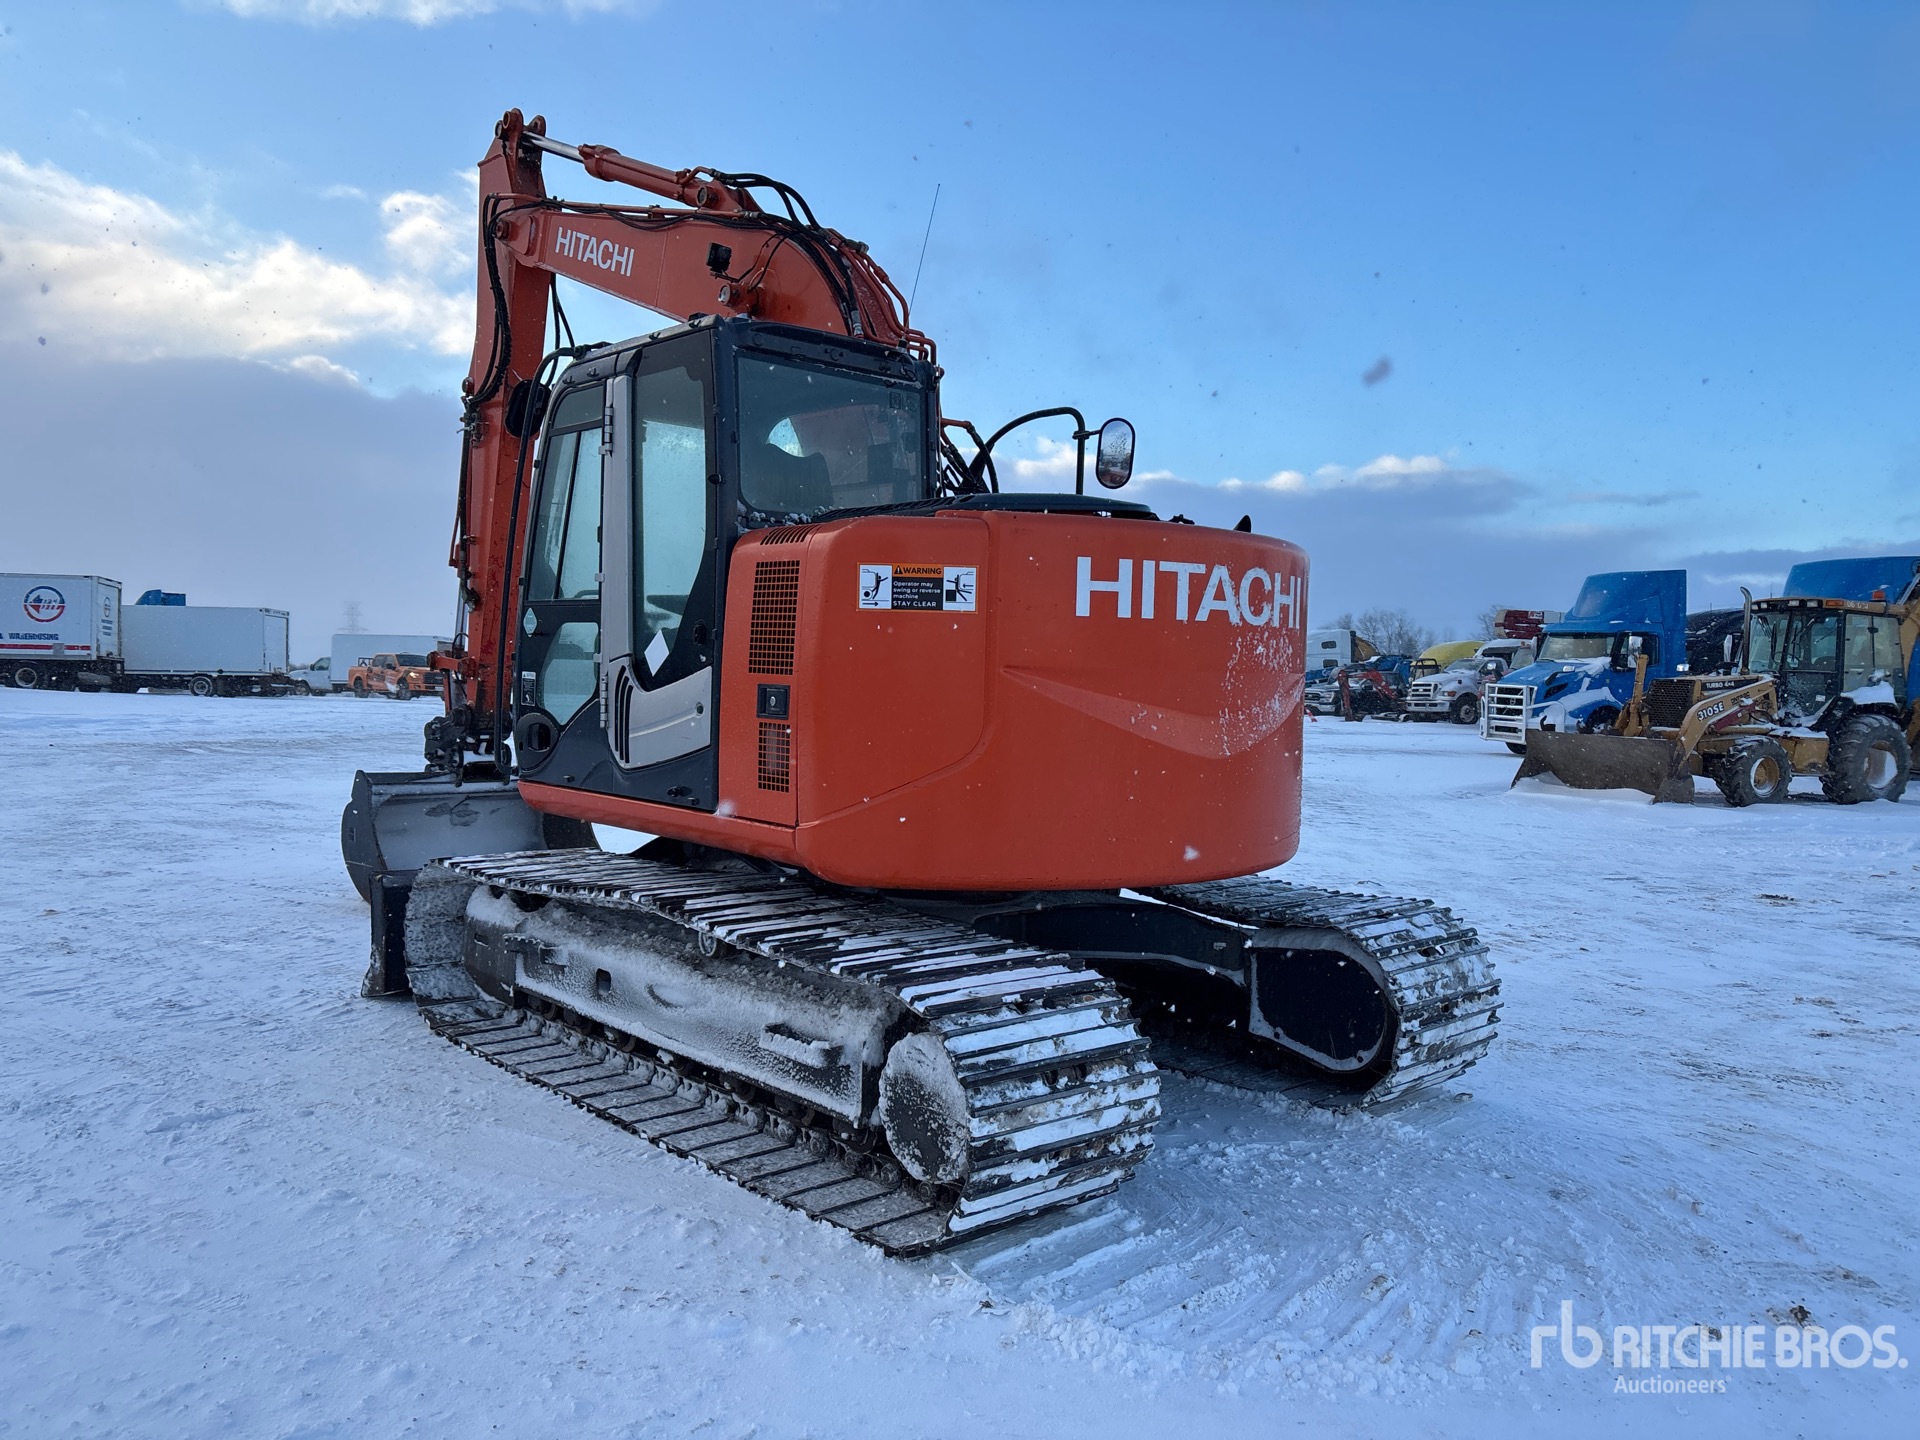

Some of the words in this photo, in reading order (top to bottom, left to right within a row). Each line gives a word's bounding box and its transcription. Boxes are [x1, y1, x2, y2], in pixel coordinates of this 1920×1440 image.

[555, 227, 635, 277] HITACHI
[1075, 556, 1301, 629] HITACHI
[8, 632, 60, 641] WAREHOUSING
[1698, 702, 1724, 720] 310SE
